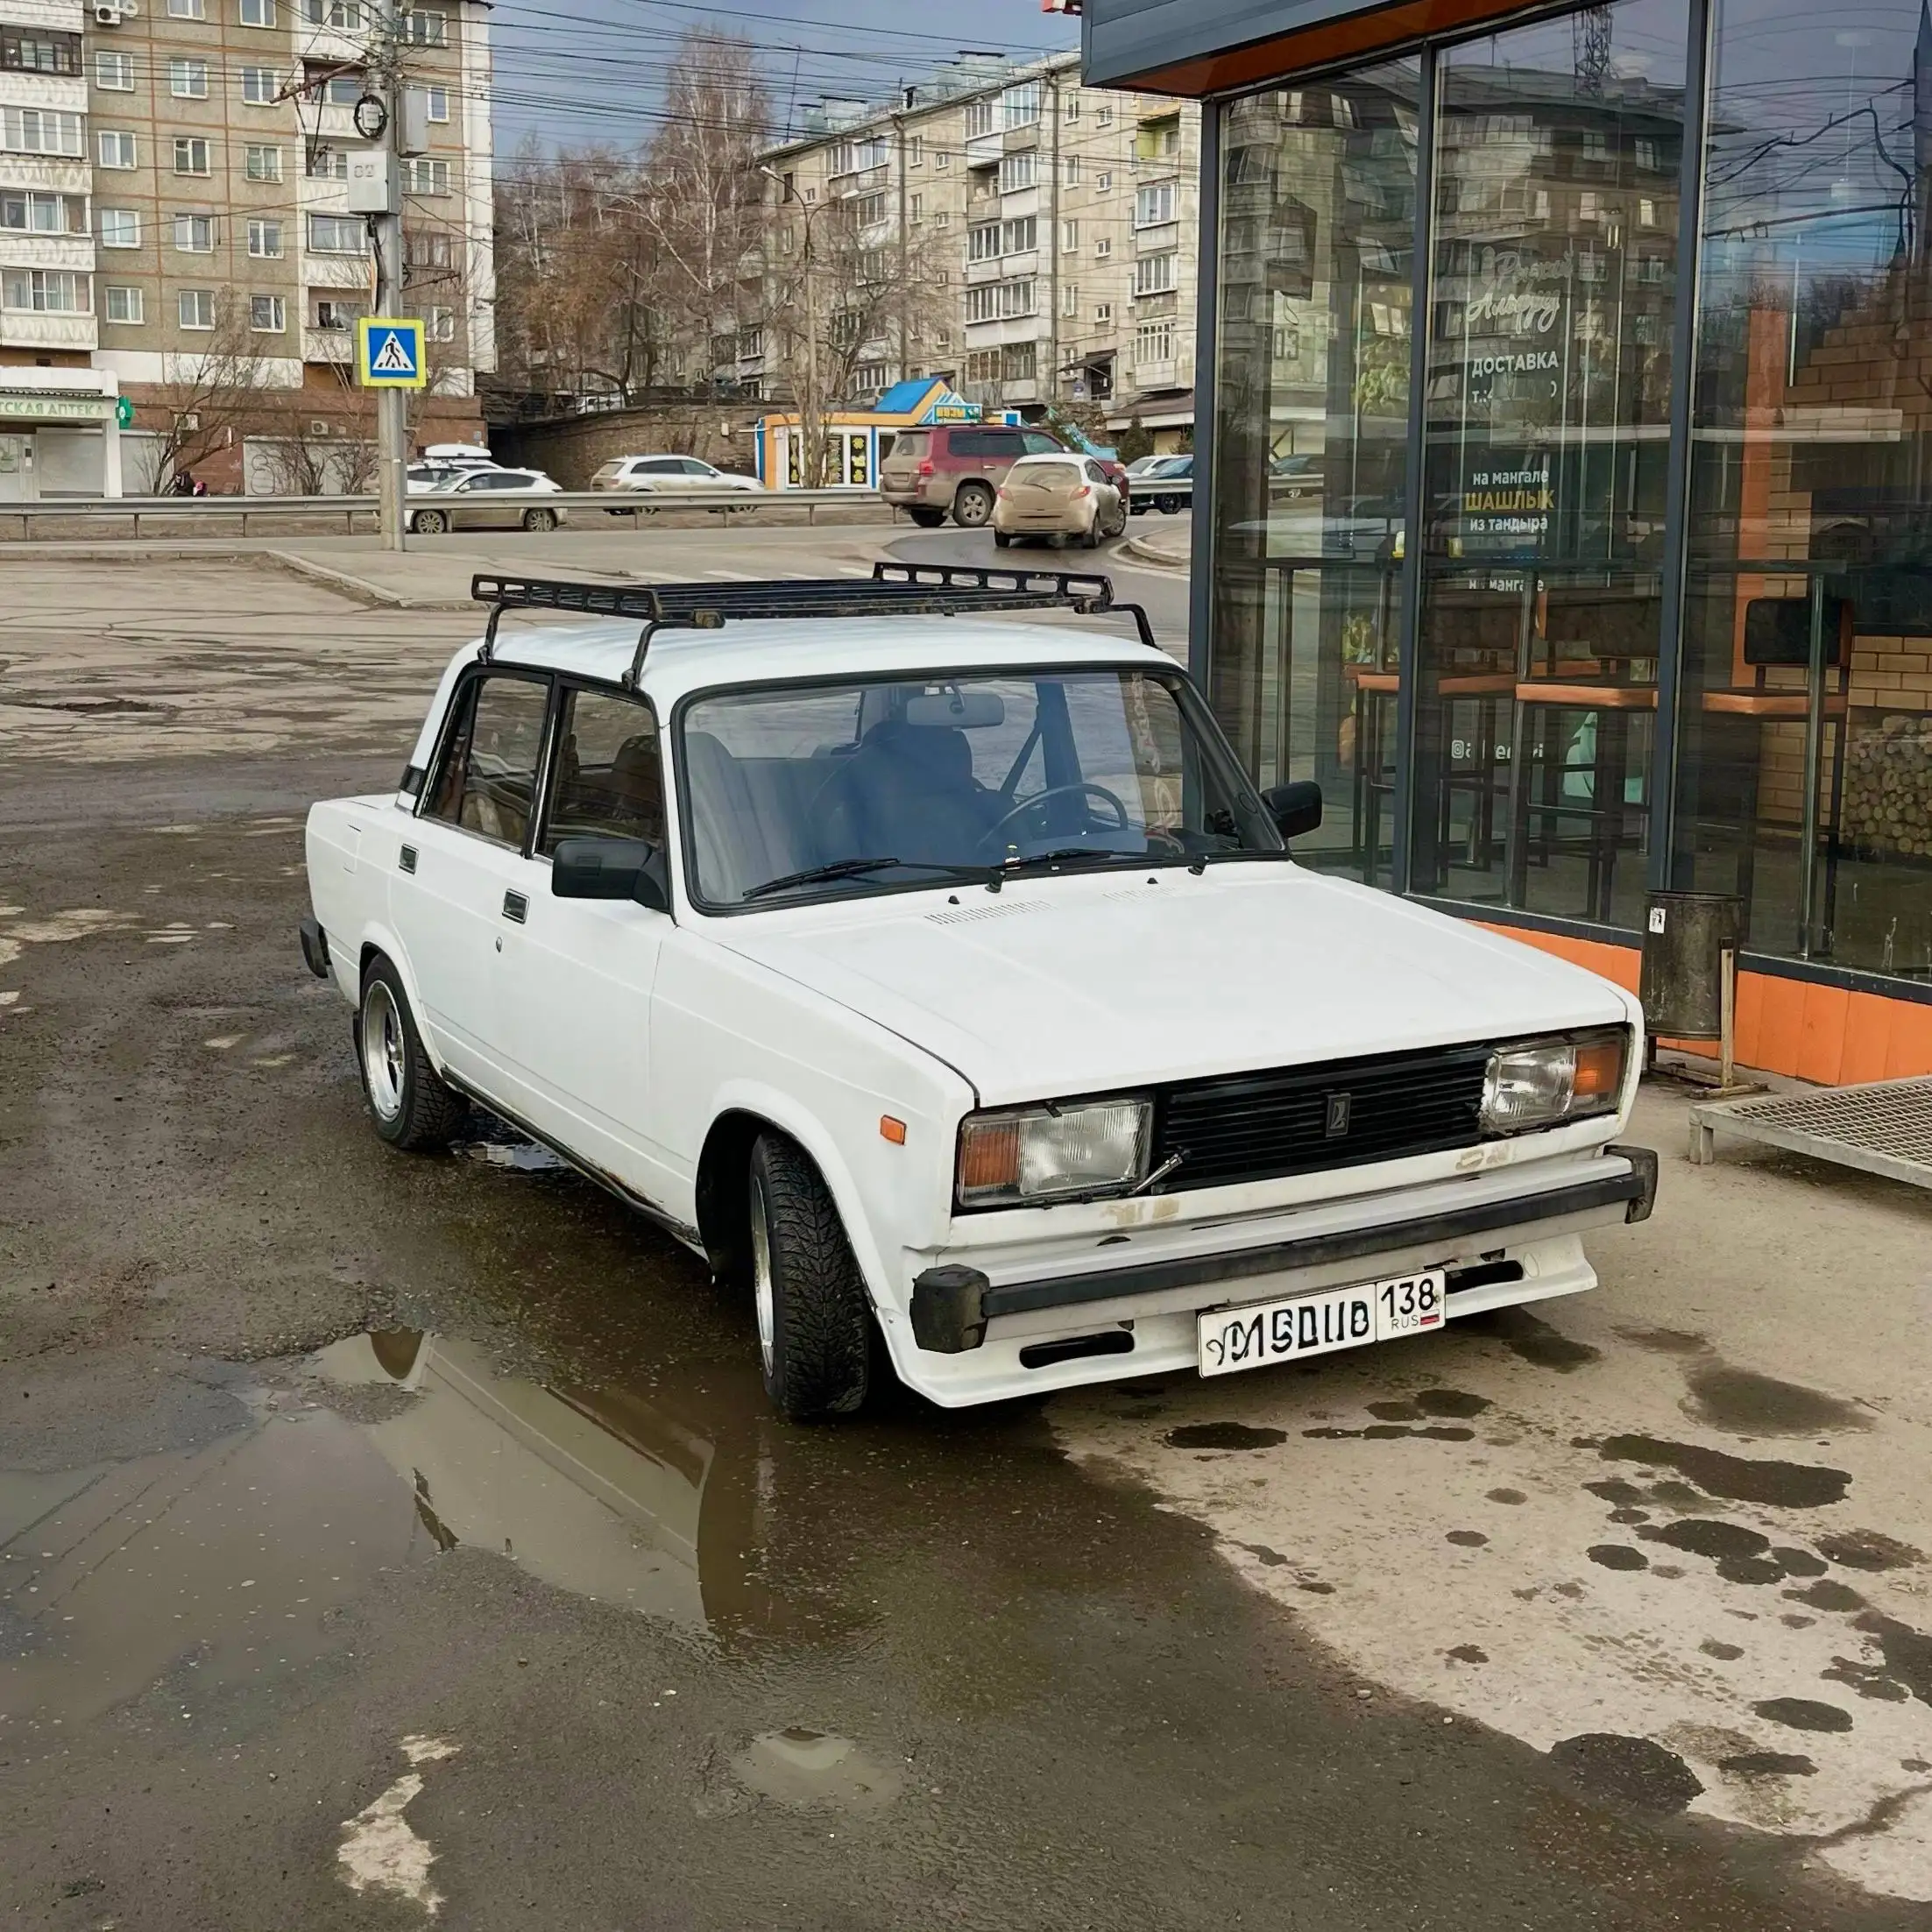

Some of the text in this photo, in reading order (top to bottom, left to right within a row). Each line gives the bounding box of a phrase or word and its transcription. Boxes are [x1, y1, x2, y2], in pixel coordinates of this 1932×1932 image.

[1471, 351, 1559, 379] ДОСТАВКА
[48, 404, 103, 415] АПТЕКА
[1473, 470, 1550, 485] на мангале
[1465, 489, 1555, 512] ШАШЛЫК
[1470, 517, 1548, 534] из тандыра
[1381, 1278, 1434, 1318] 138
[1391, 1314, 1419, 1331] RUS
